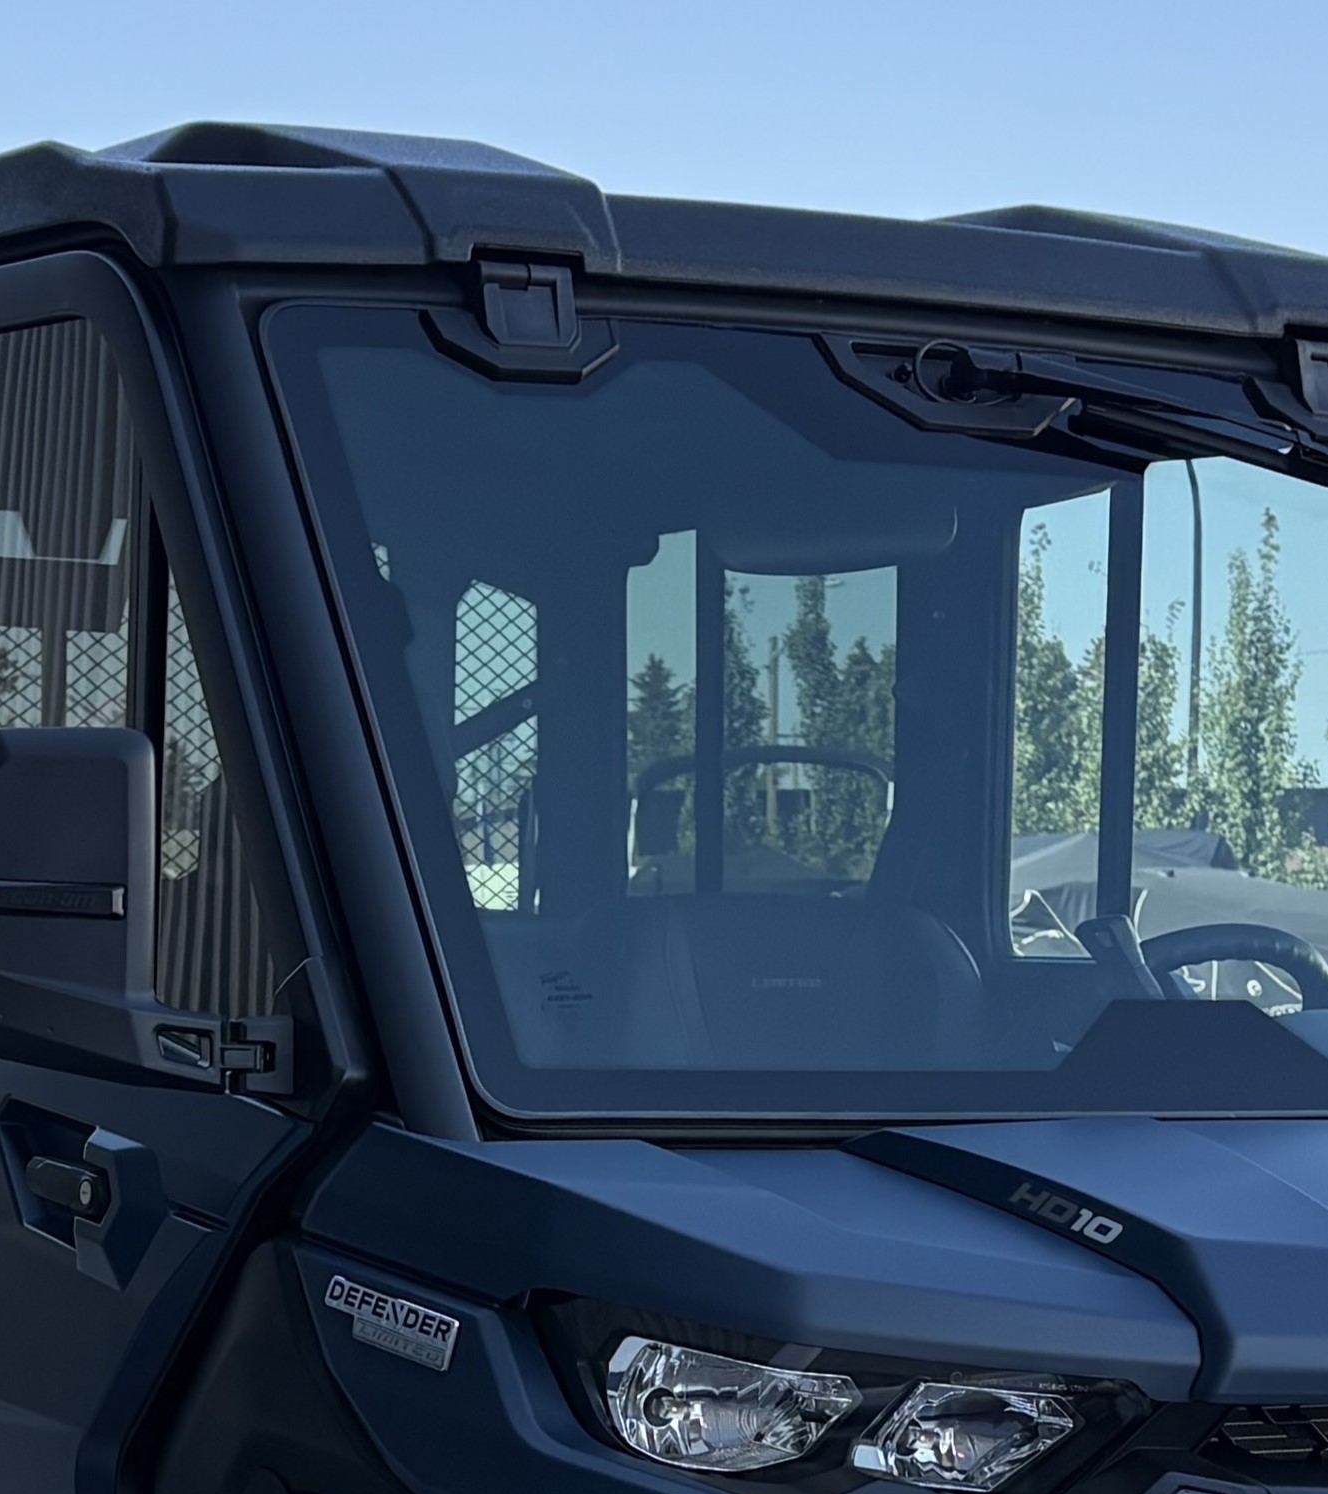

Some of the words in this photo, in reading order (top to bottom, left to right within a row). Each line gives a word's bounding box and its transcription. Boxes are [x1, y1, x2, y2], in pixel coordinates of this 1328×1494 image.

[1008, 1182, 1123, 1245] HD10
[328, 1280, 452, 1343] DEFENDER
[359, 1325, 441, 1362] LIMITED
